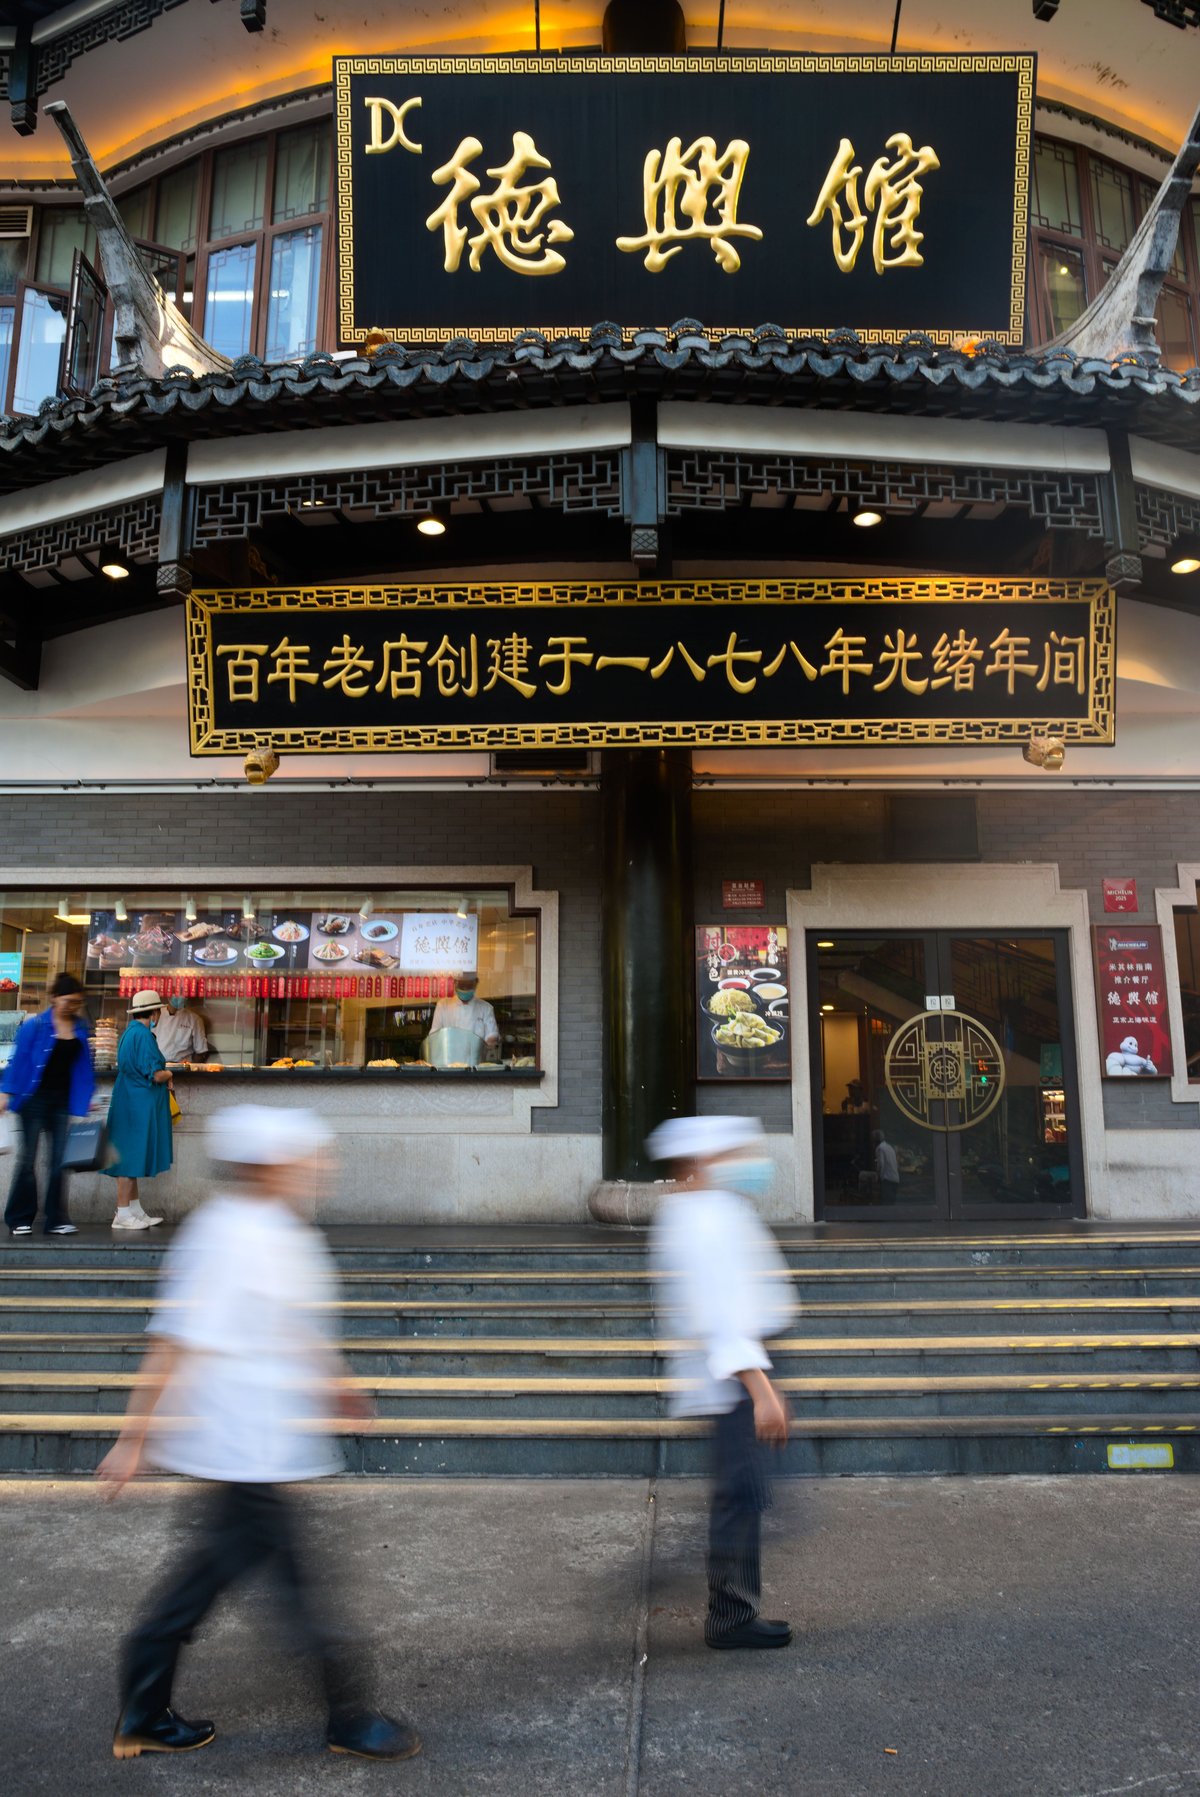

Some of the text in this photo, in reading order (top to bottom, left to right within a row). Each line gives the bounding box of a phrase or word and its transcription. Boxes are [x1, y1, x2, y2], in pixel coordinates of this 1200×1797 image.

[215, 628, 1086, 705] 百年老店创建于一八七八年光绪年间
[1108, 963, 1153, 972] 米其林指南
[1114, 976, 1149, 985] 推介餐厅
